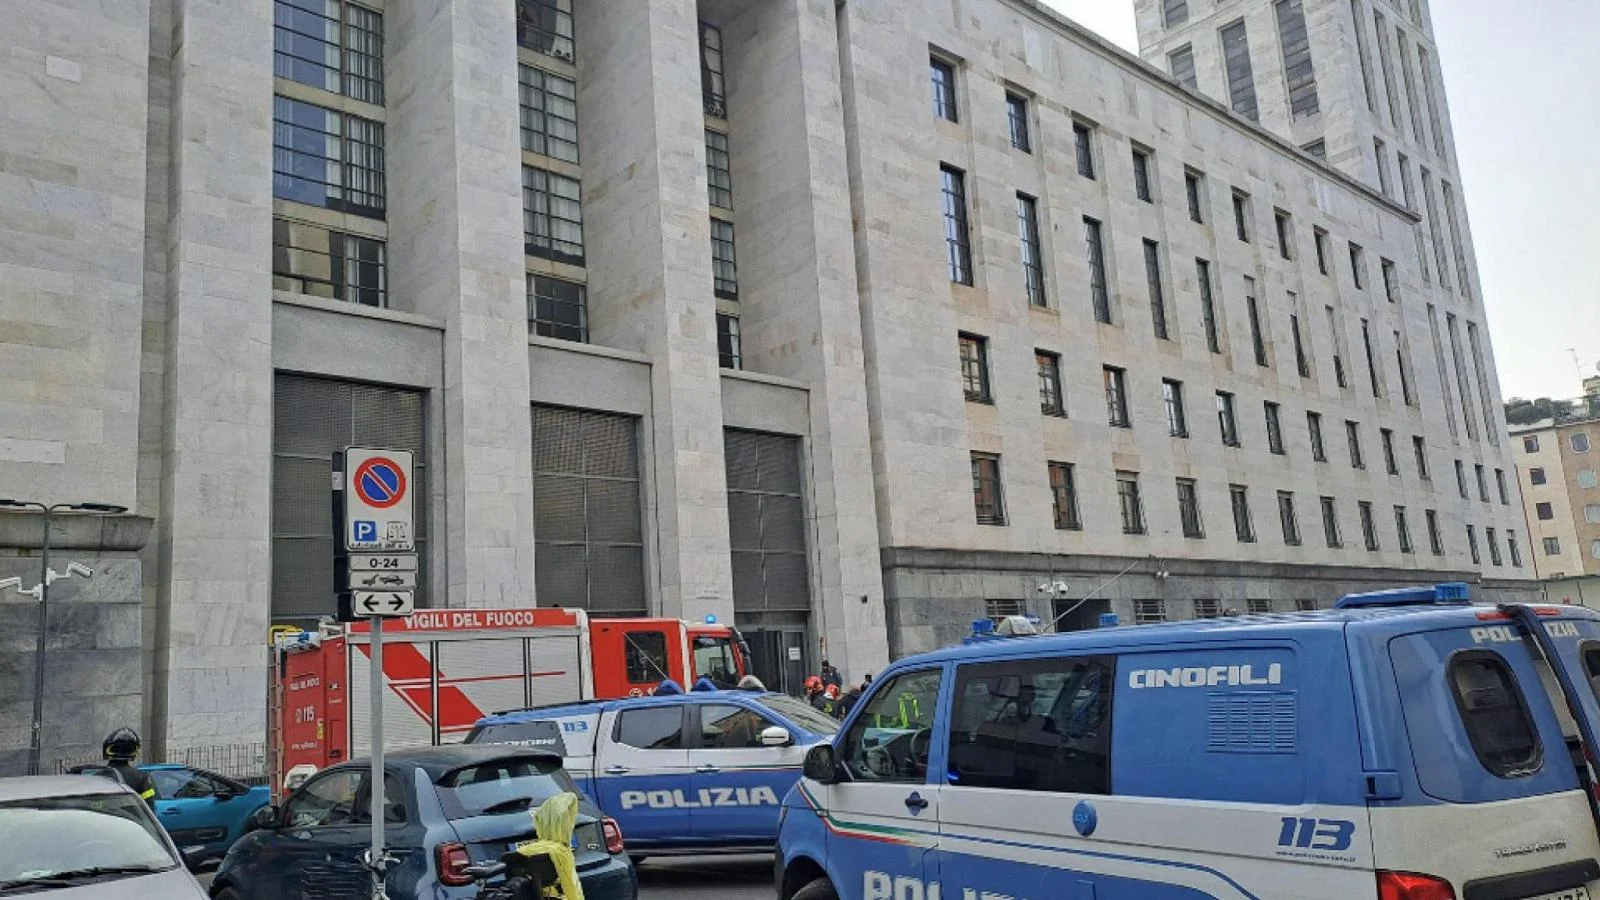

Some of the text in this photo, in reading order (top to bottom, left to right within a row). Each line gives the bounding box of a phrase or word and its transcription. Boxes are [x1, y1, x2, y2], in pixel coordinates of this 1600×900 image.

[369, 558, 399, 569] 0-24
[404, 611, 535, 629] VIGILI DEL FUOCO
[1129, 663, 1281, 688] CINOFILI
[562, 720, 589, 732] 113
[620, 786, 779, 808] POLIZIA
[1278, 817, 1355, 850] 113
